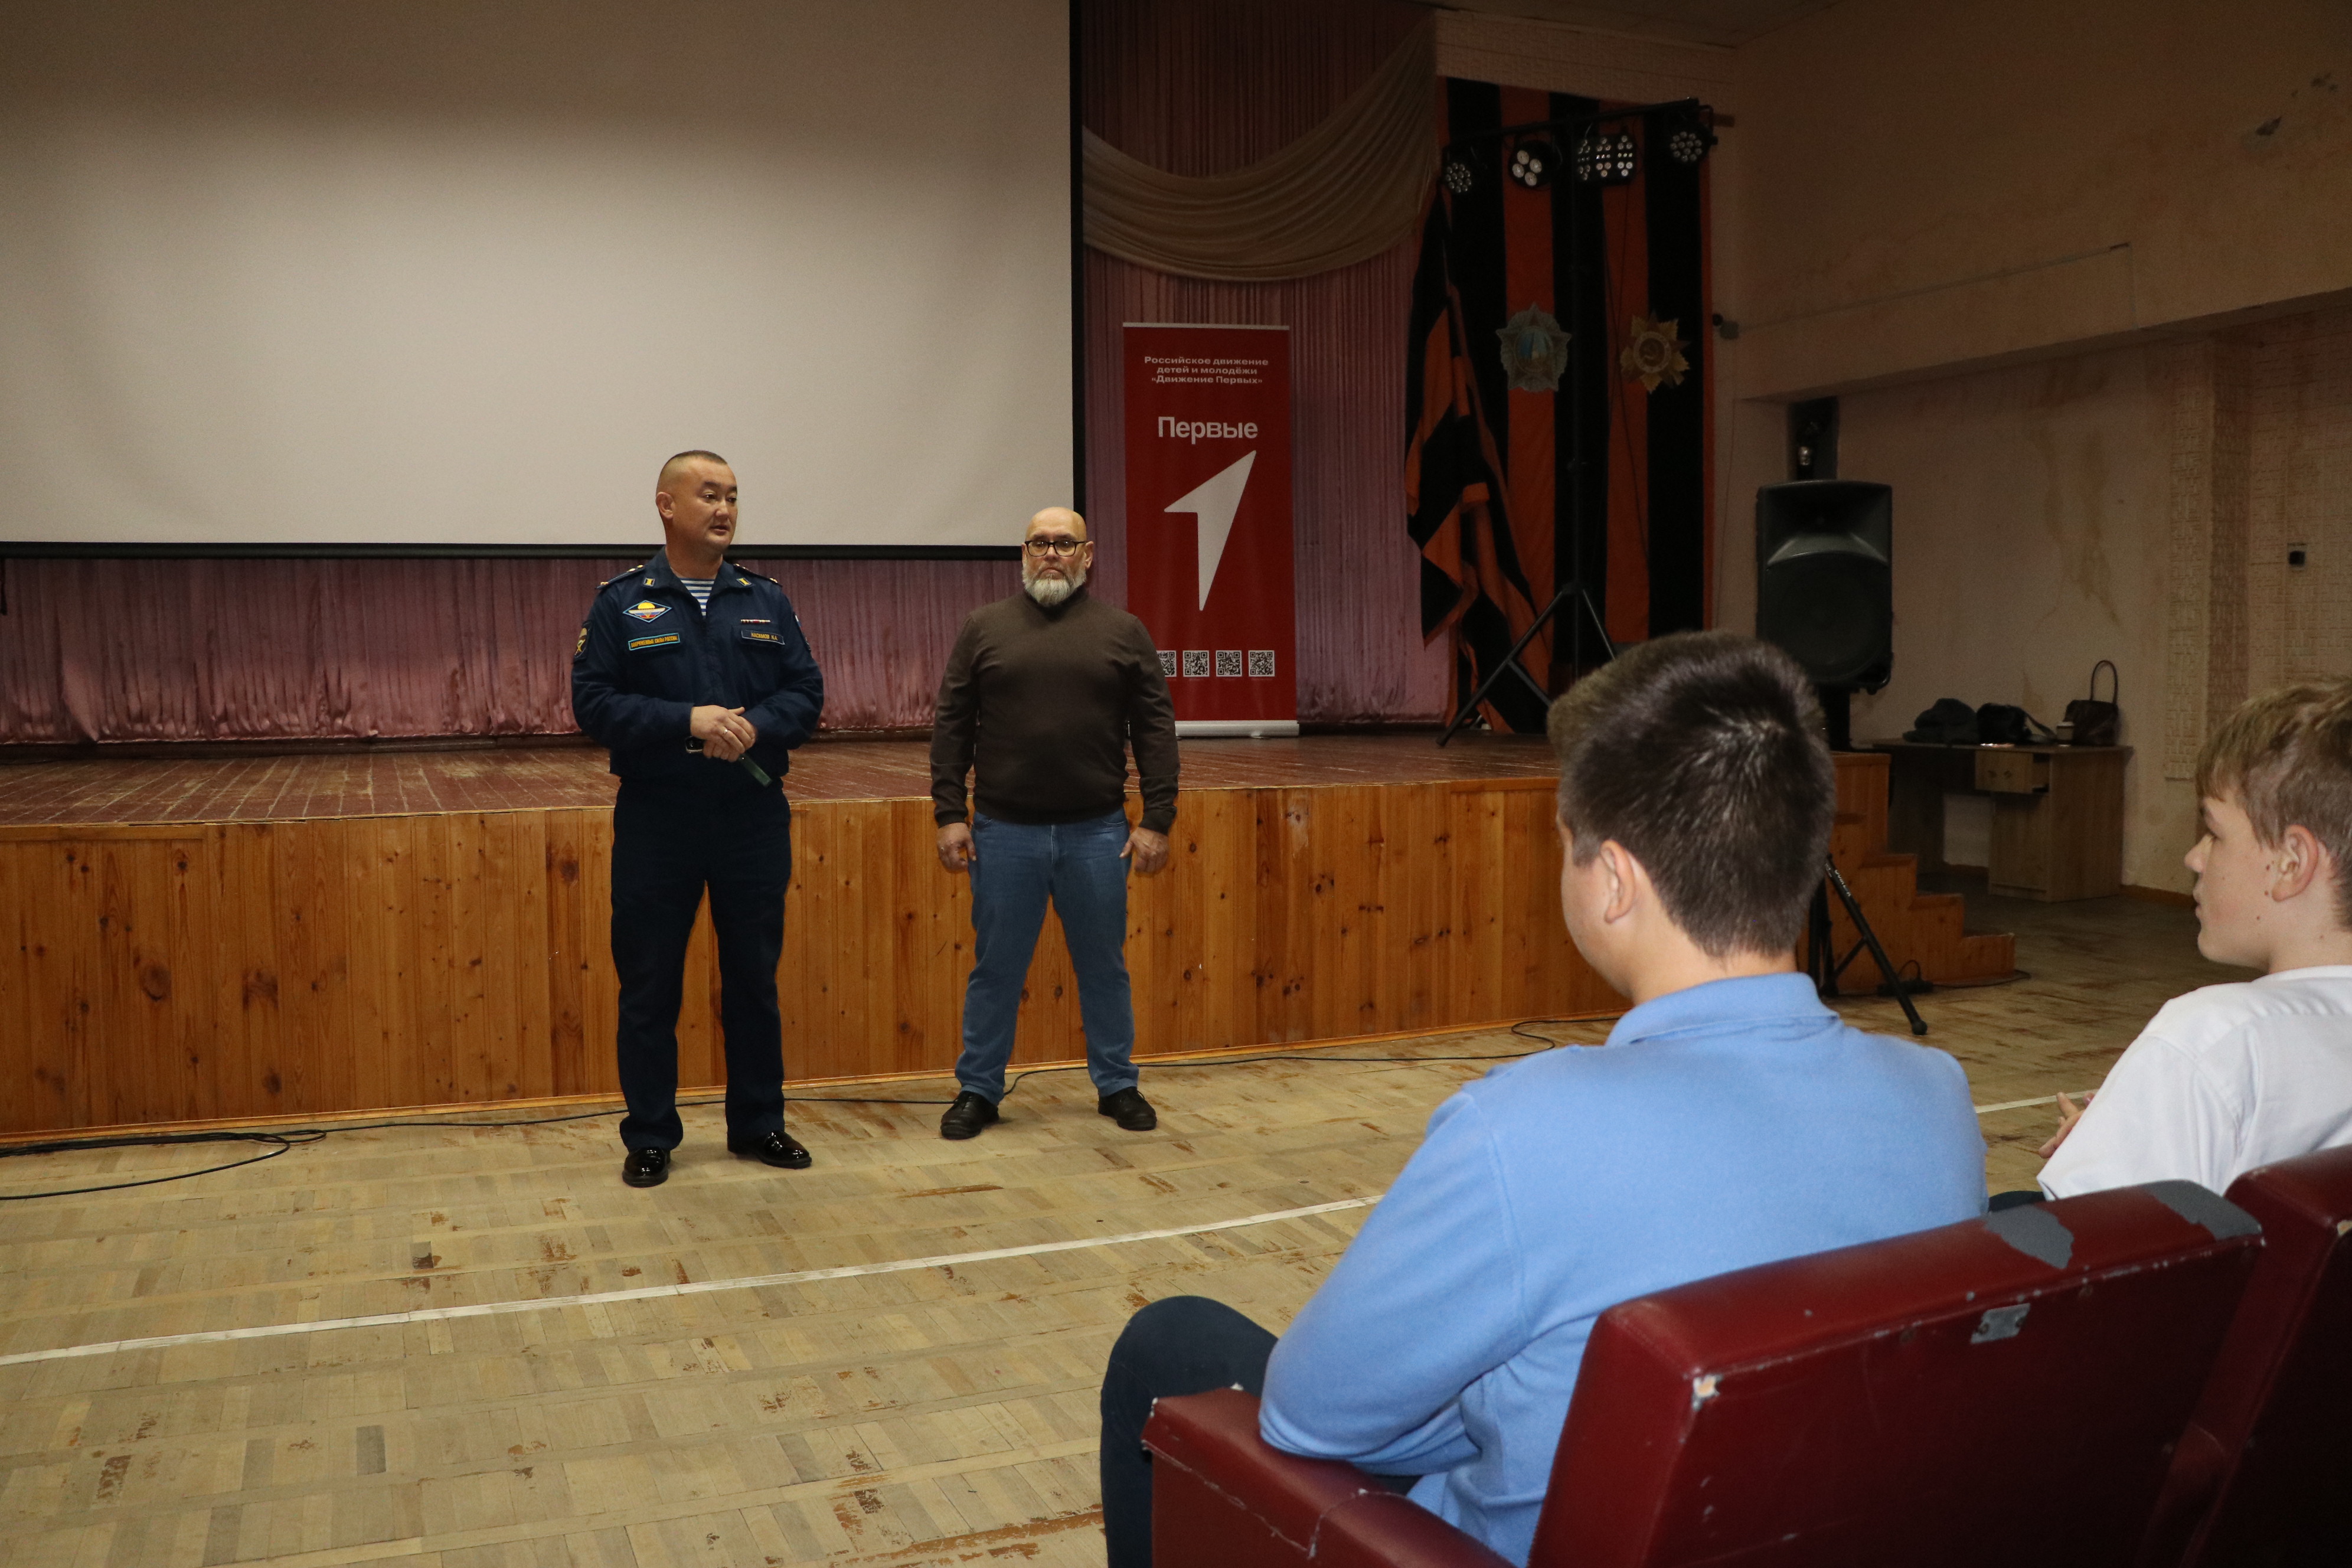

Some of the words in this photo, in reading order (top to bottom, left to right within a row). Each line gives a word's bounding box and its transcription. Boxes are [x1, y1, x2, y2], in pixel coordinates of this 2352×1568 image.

[1144, 356, 1211, 364] Российское
[1157, 365, 1189, 374] детей
[1200, 367, 1257, 375] молодёжи
[1151, 375, 1214, 384] «Движение
[1216, 376, 1262, 385] Первых»
[1158, 416, 1258, 445] Первые
